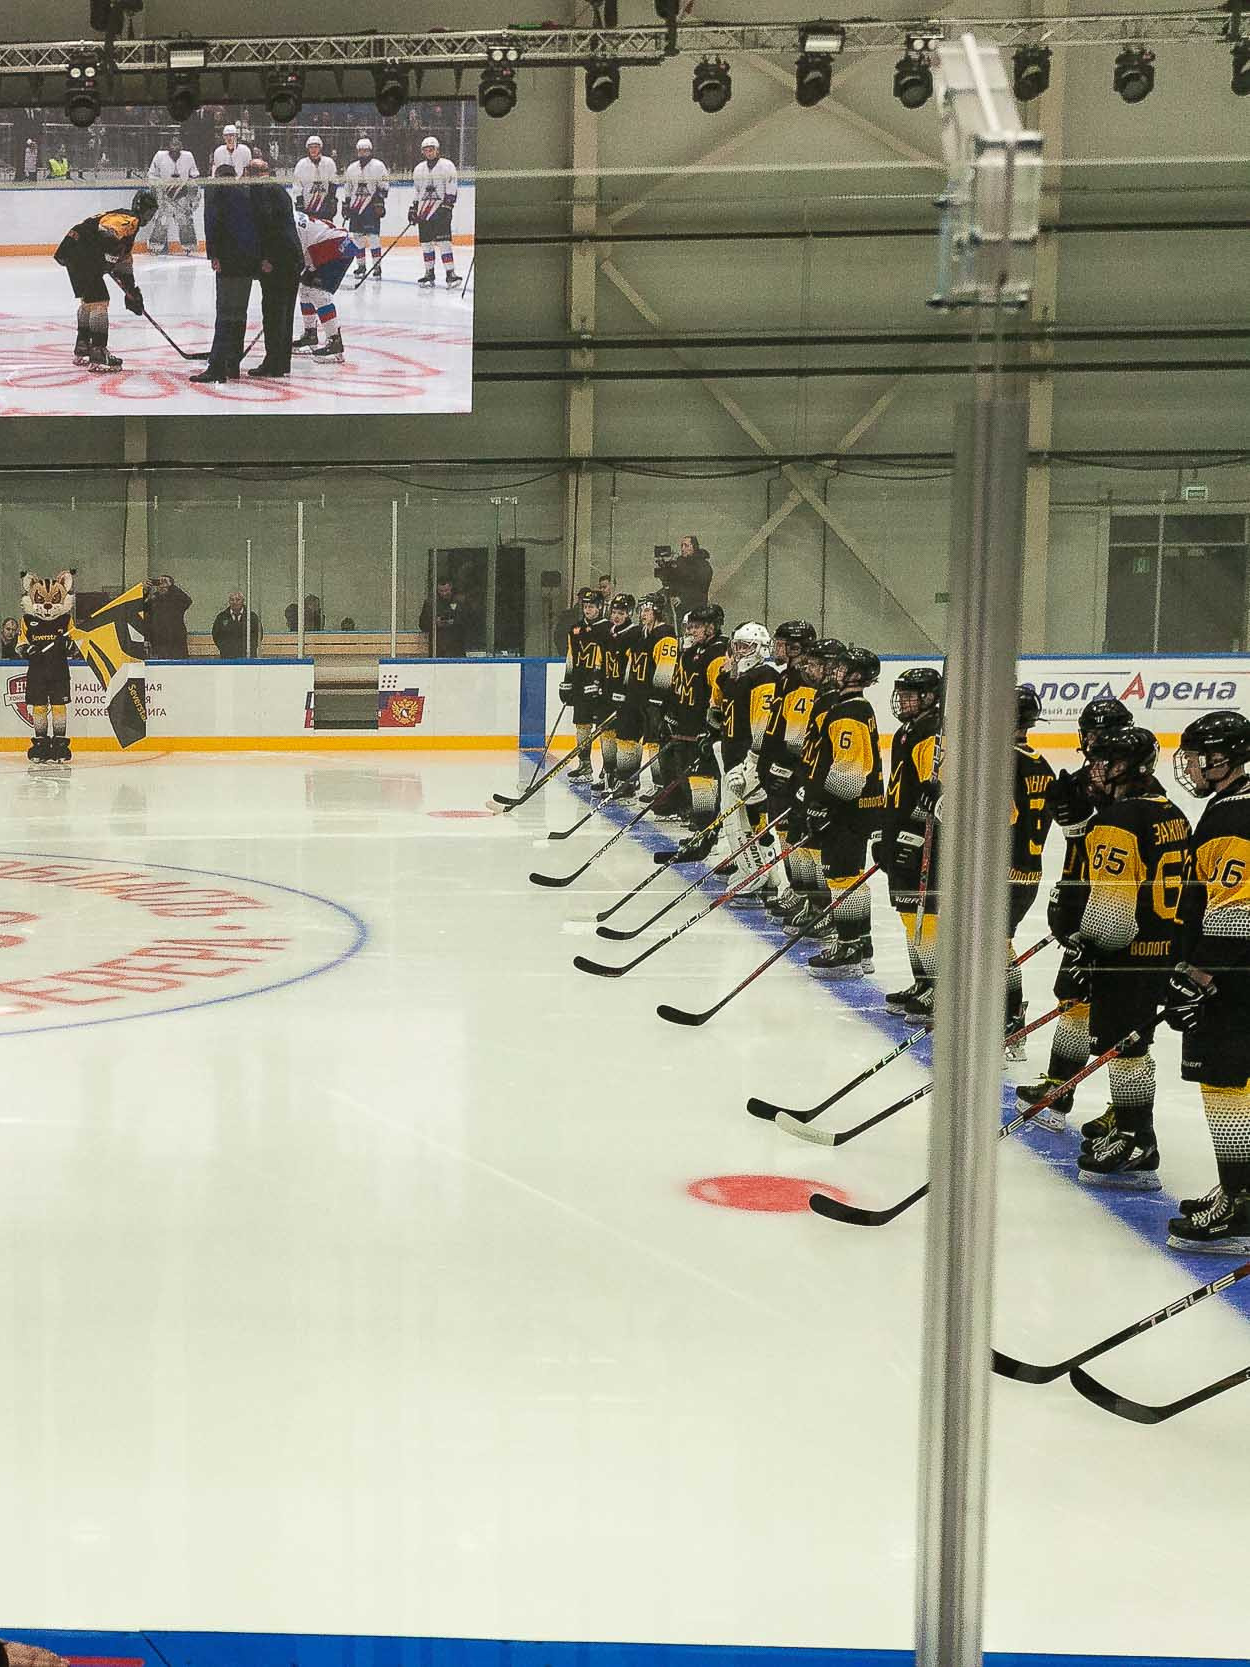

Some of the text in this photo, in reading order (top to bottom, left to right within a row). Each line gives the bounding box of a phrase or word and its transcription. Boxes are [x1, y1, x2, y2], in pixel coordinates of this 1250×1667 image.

[661, 645, 677, 657] 56
[839, 730, 853, 751] 6
[1092, 844, 1128, 877] 65
[1138, 1272, 1237, 1329] TRUE
